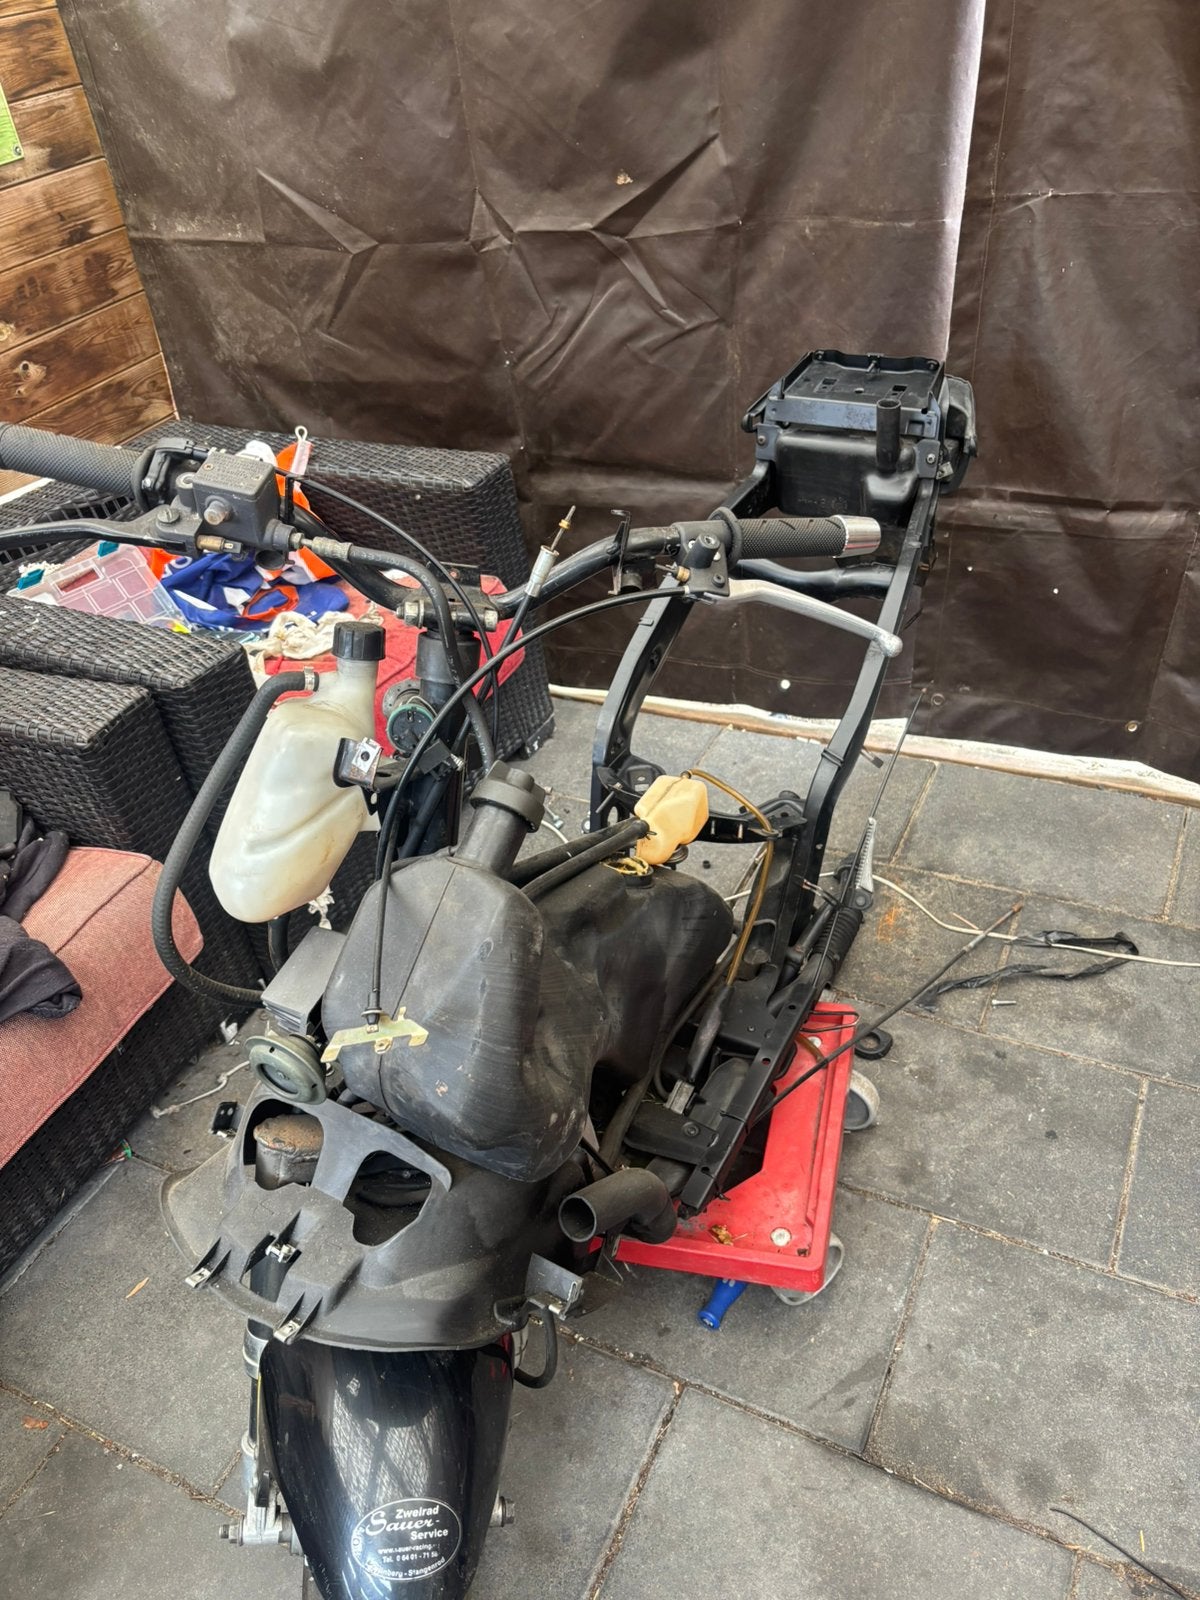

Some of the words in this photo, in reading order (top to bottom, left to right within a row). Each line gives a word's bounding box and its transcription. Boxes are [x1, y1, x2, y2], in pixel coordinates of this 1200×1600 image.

[395, 1505, 440, 1519] Zweirad
[410, 1528, 449, 1541] Service
[378, 1543, 441, 1555] www.sauer-racing.
[408, 1556, 446, 1577] Stangenrod
